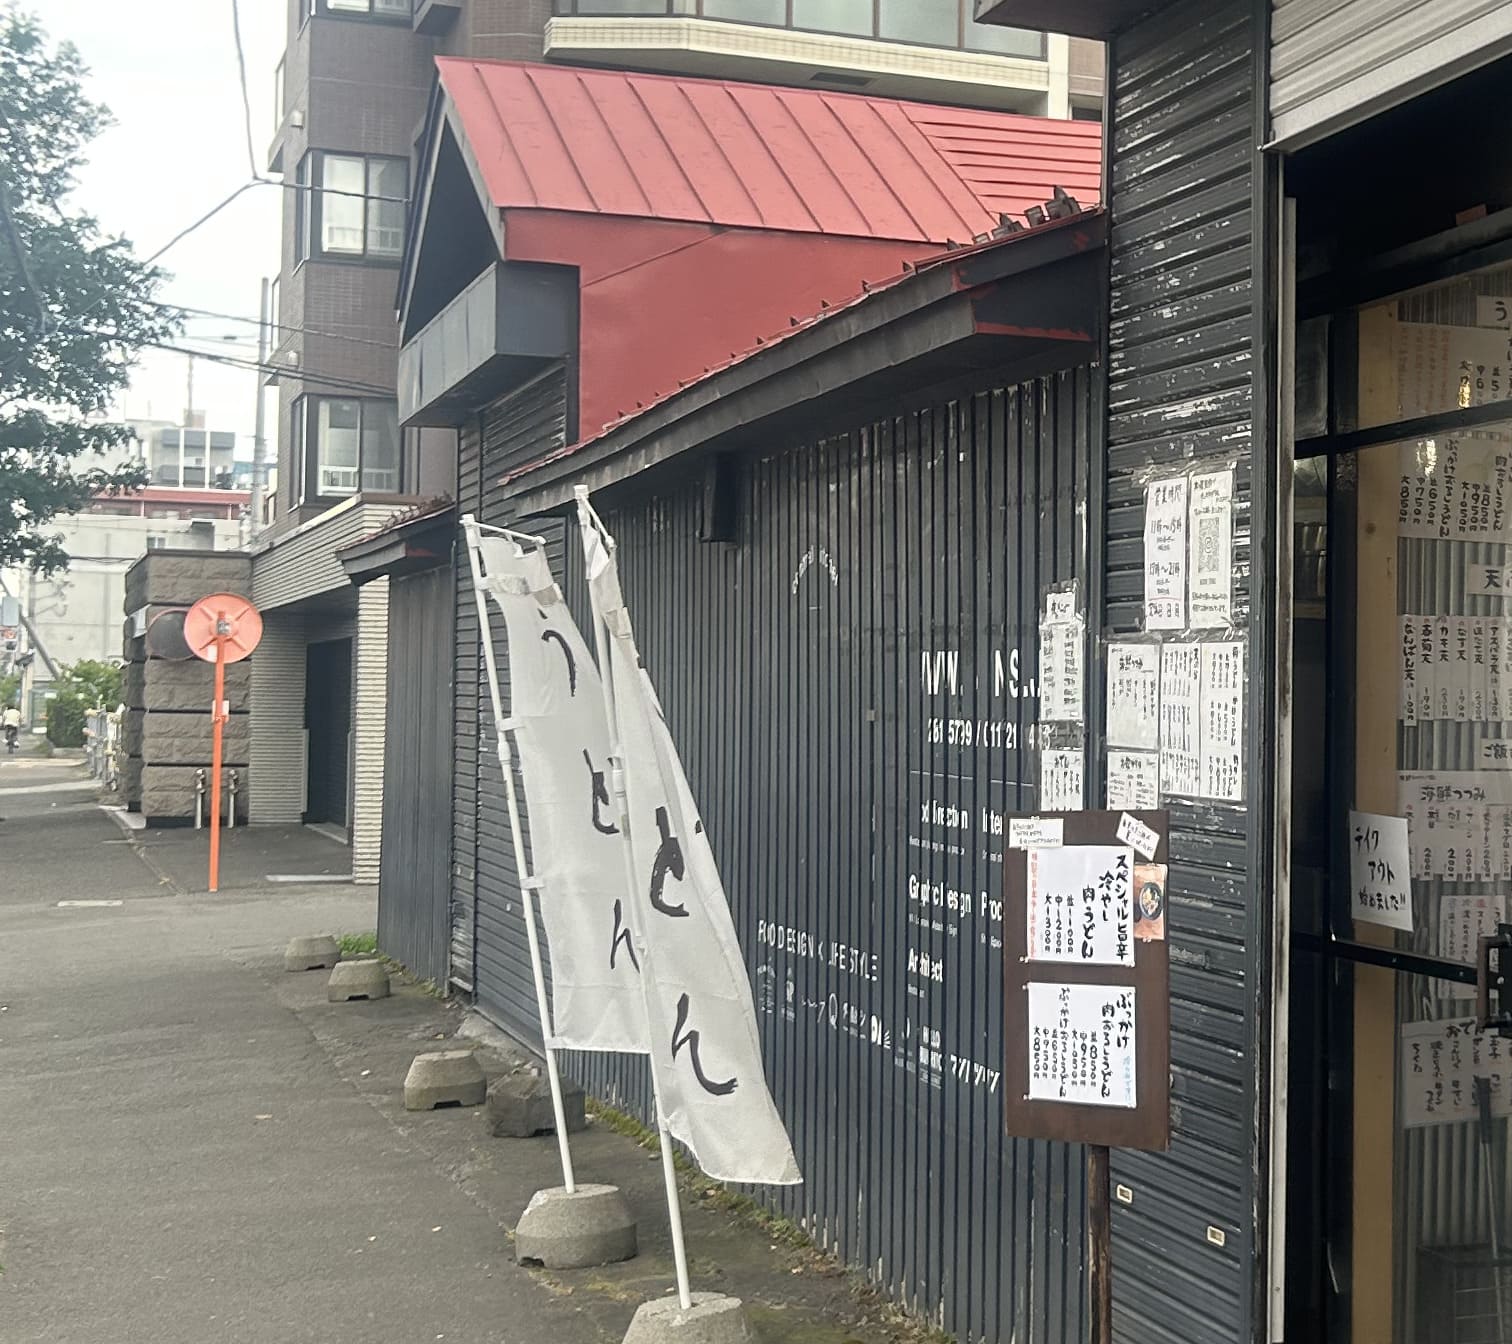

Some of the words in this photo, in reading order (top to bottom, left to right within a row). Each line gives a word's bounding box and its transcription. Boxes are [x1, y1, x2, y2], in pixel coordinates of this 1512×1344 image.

[1354, 826, 1380, 853] テイク
[1368, 859, 1396, 885] アウト
[1081, 885, 1096, 959] 肉うどん
[1098, 870, 1114, 922] 冷やし
[1115, 854, 1129, 961] スペシャル旨辛
[645, 805, 738, 1096] どん
[1101, 1001, 1115, 1098] 肉おろしうどん
[1116, 992, 1133, 1049] ぶっかけ
